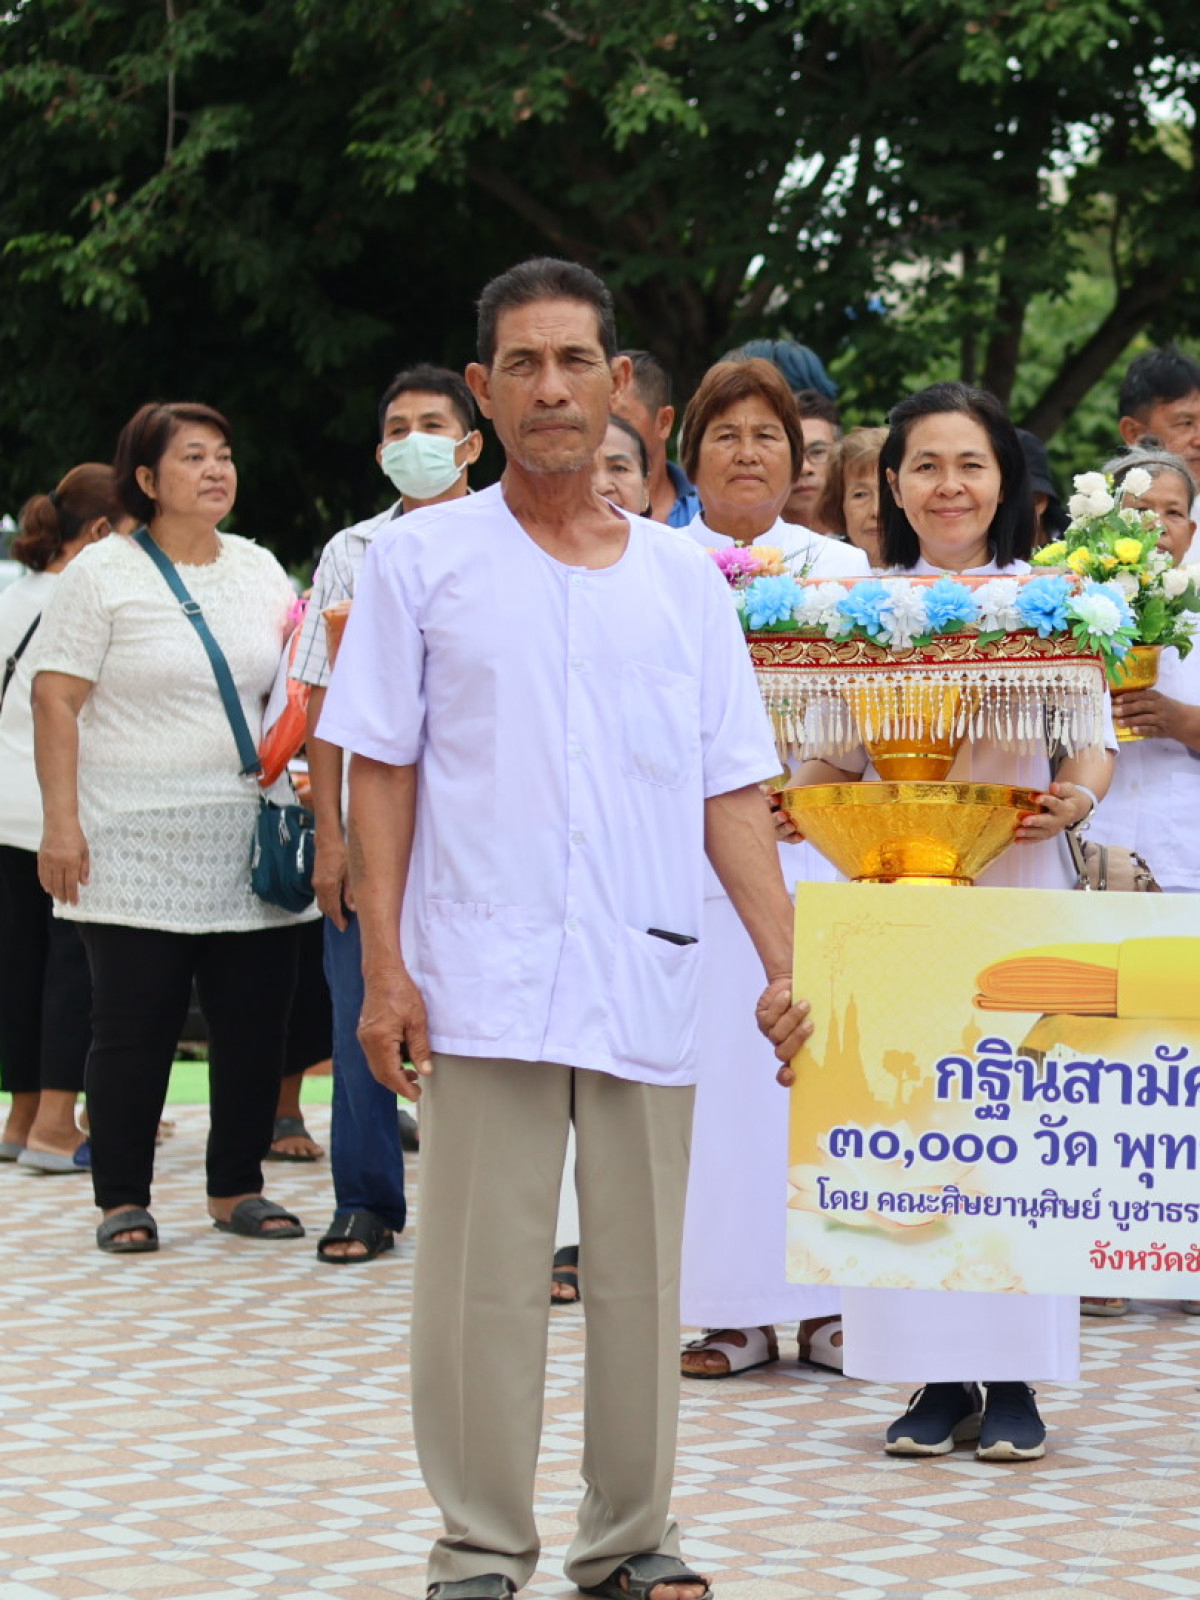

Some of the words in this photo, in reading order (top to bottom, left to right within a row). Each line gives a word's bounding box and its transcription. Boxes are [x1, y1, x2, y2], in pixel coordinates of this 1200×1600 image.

[829, 1126, 1019, 1168] ๓๐,๐๐๐
[1034, 1114, 1098, 1167] วัด
[817, 1177, 869, 1211] โดย
[877, 1185, 1102, 1229] คณะศิษยานุศิษย์
